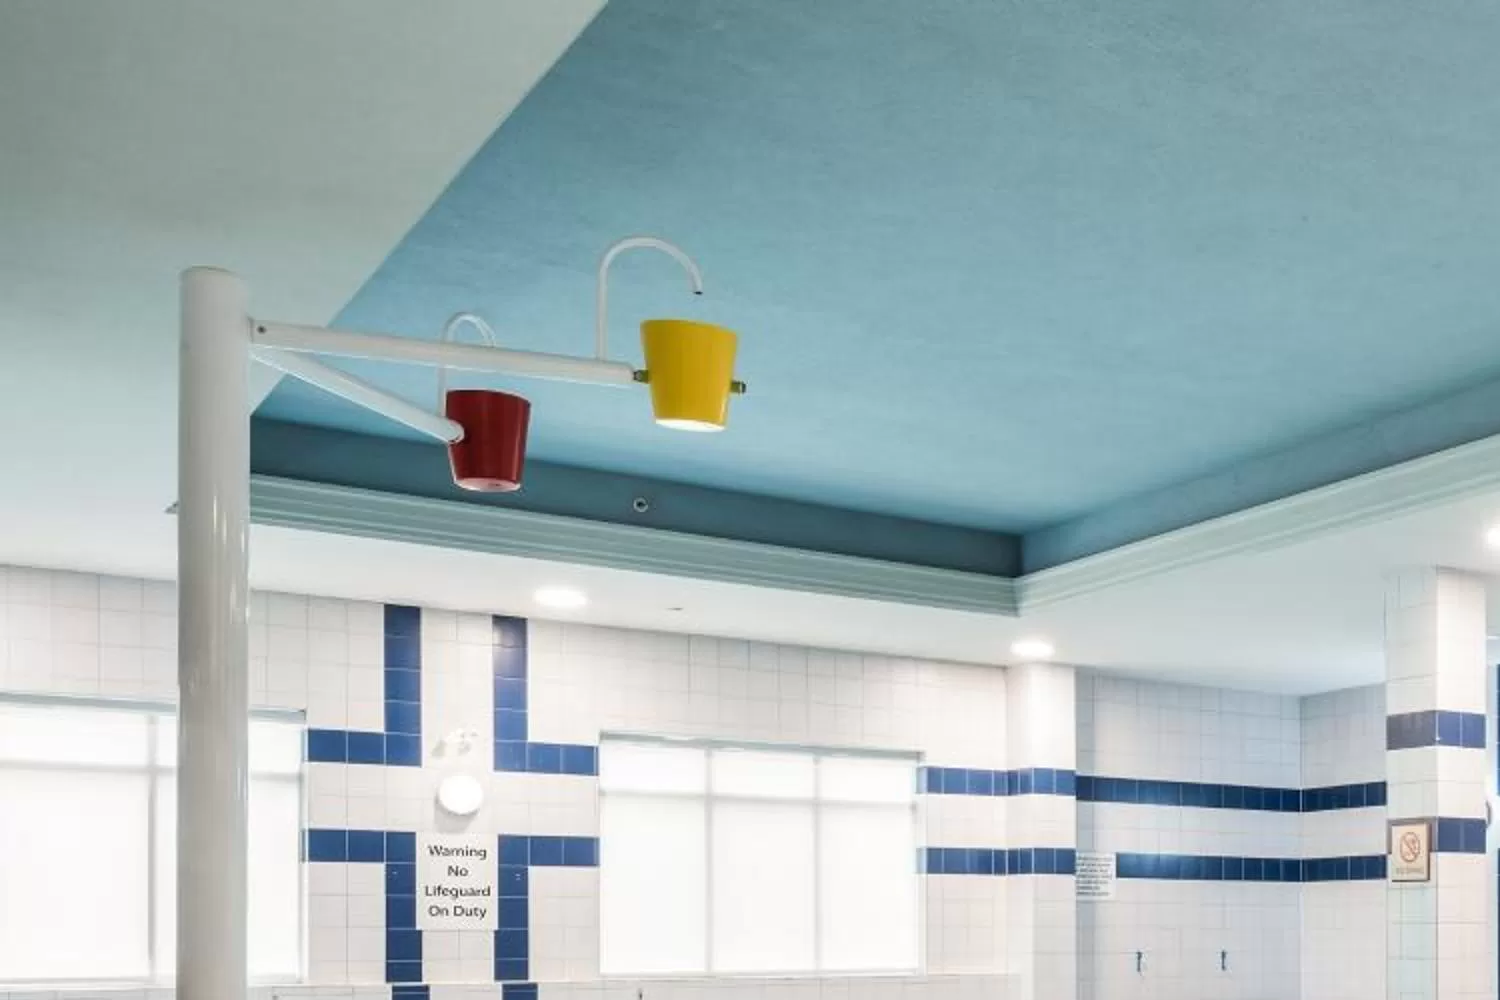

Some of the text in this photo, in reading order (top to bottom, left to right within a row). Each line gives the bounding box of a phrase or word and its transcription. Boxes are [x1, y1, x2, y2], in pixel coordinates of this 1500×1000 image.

[427, 845, 488, 860] Warning
[447, 865, 469, 877] No
[425, 884, 492, 900] Lifeguard
[428, 905, 487, 920] On Duty
